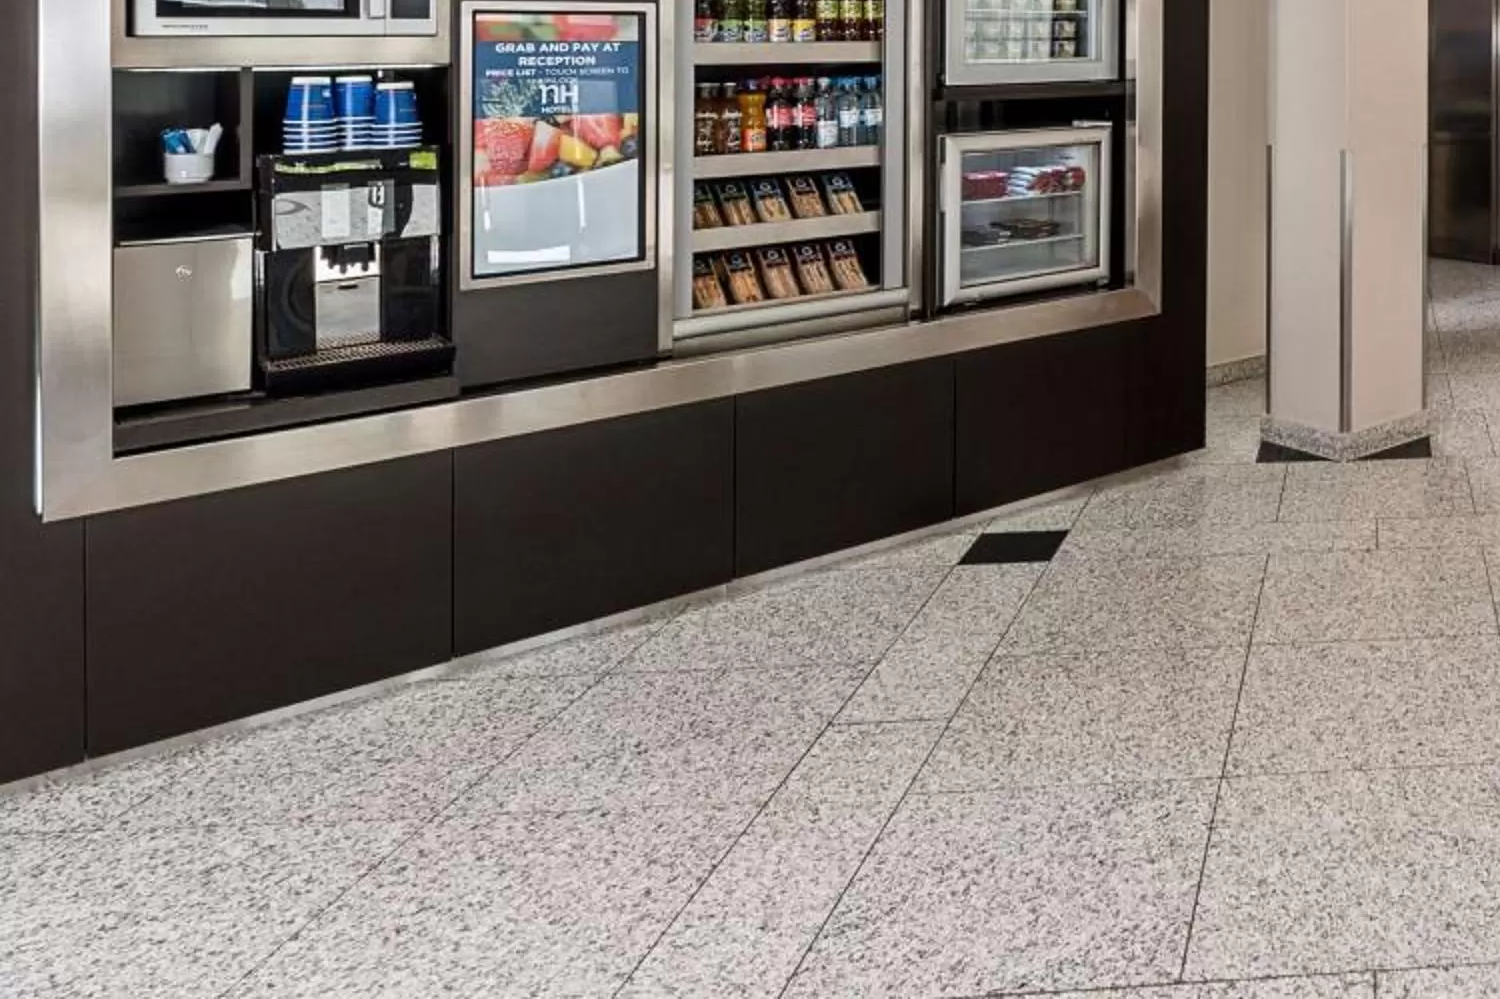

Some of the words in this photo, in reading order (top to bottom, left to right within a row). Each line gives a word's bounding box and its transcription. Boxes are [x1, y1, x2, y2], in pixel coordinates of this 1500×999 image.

[495, 42, 536, 53] GRAB
[539, 42, 569, 53] AND
[572, 42, 599, 53] PAY
[602, 42, 621, 52] AT
[518, 56, 596, 66] RECEPTION
[515, 68, 537, 76] LIST
[545, 67, 577, 76] TOUCH
[579, 66, 615, 75] SCREEN
[616, 66, 629, 74] TO
